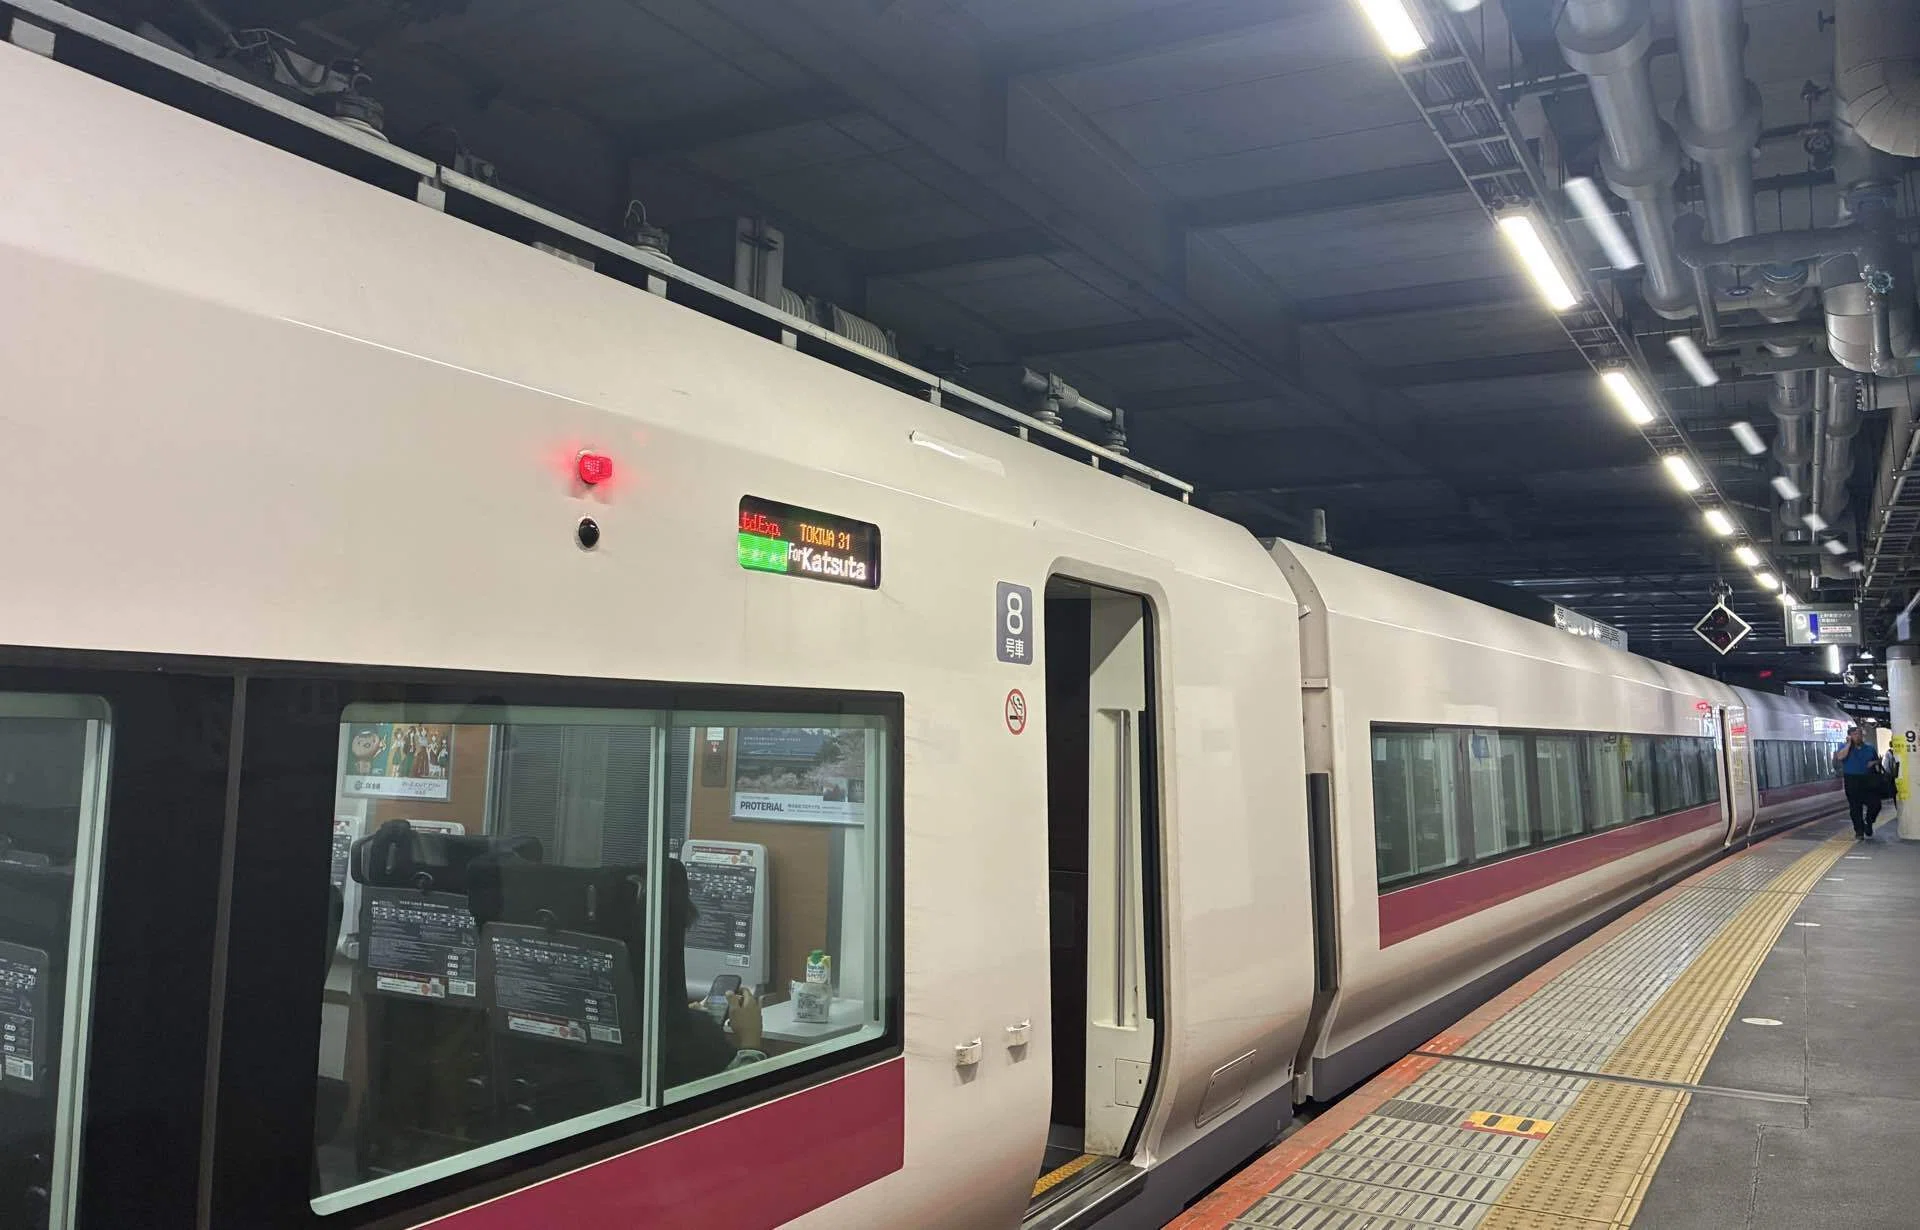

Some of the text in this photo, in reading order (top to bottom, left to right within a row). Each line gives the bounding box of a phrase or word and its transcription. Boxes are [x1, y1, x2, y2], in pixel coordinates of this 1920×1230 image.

[800, 524, 850, 550] TOKIWA 31
[788, 542, 804, 562] For
[801, 546, 866, 580] Katsuta
[1006, 591, 1024, 635] 8
[1006, 637, 1025, 659] 号車
[1905, 730, 1916, 743] 9
[740, 800, 785, 812] PROTERIAL
